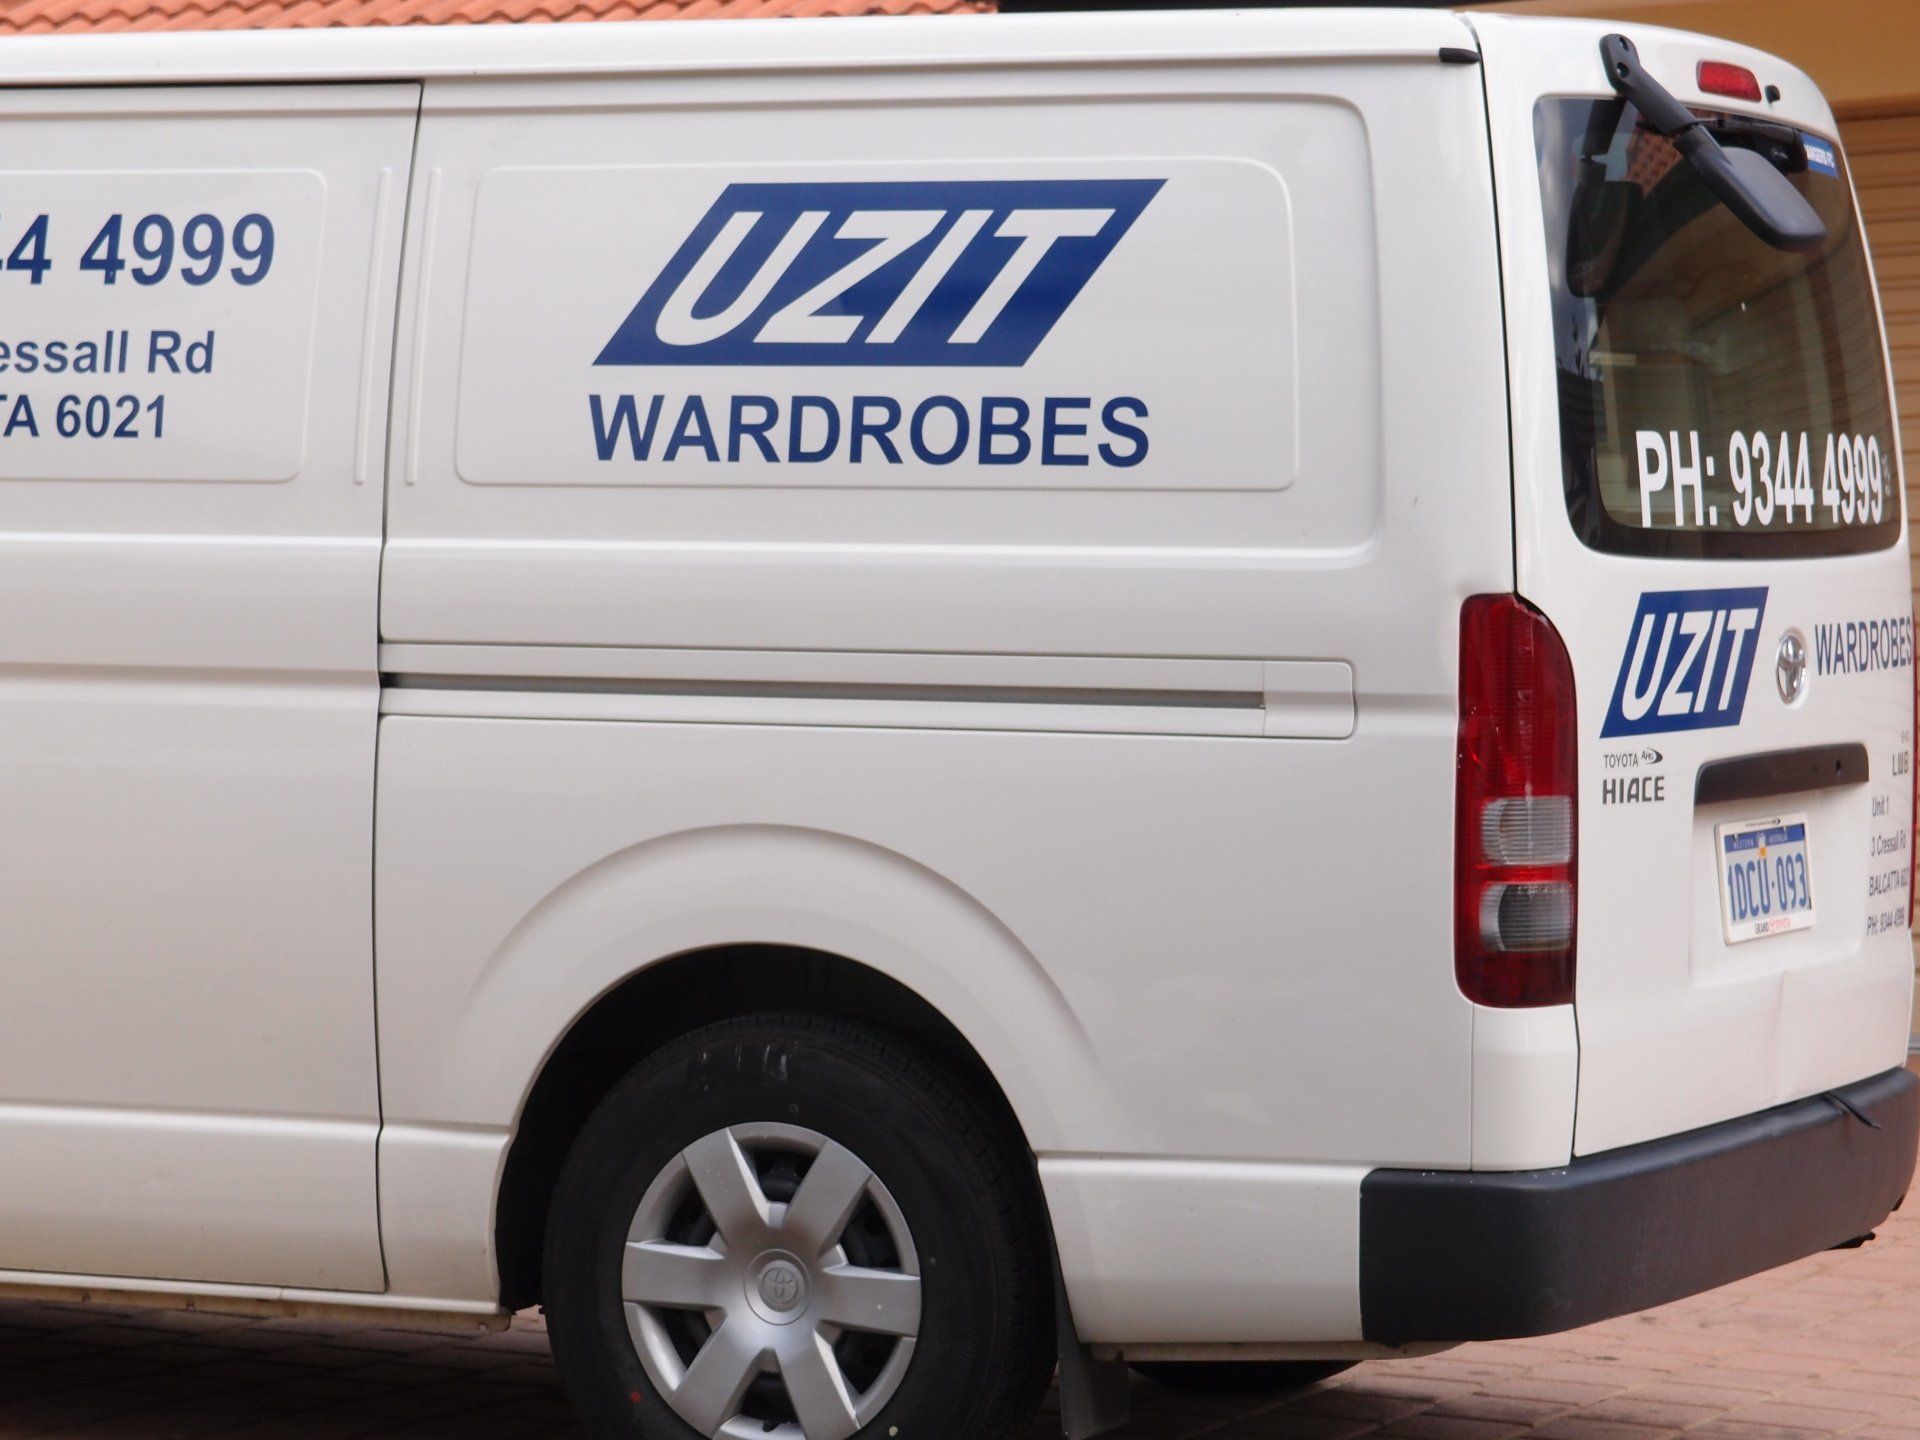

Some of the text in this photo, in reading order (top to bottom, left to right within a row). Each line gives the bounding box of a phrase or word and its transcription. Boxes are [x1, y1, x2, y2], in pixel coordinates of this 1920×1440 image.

[0, 213, 275, 286] 4 4999
[655, 208, 1117, 346] UZIT
[147, 330, 215, 374] Rd
[0, 394, 165, 438] A 6021
[588, 394, 1150, 468] WARDROBES
[1635, 430, 1718, 528] PH:
[1728, 430, 1814, 526] 9344
[1822, 433, 1882, 525] 4999
[1622, 607, 1759, 721] UZIT
[1814, 616, 1912, 676] WARDROBES
[1602, 776, 1665, 805] HIACE
[1603, 752, 1639, 769] TOYOTA
[1869, 869, 1900, 897] BALCATTA
